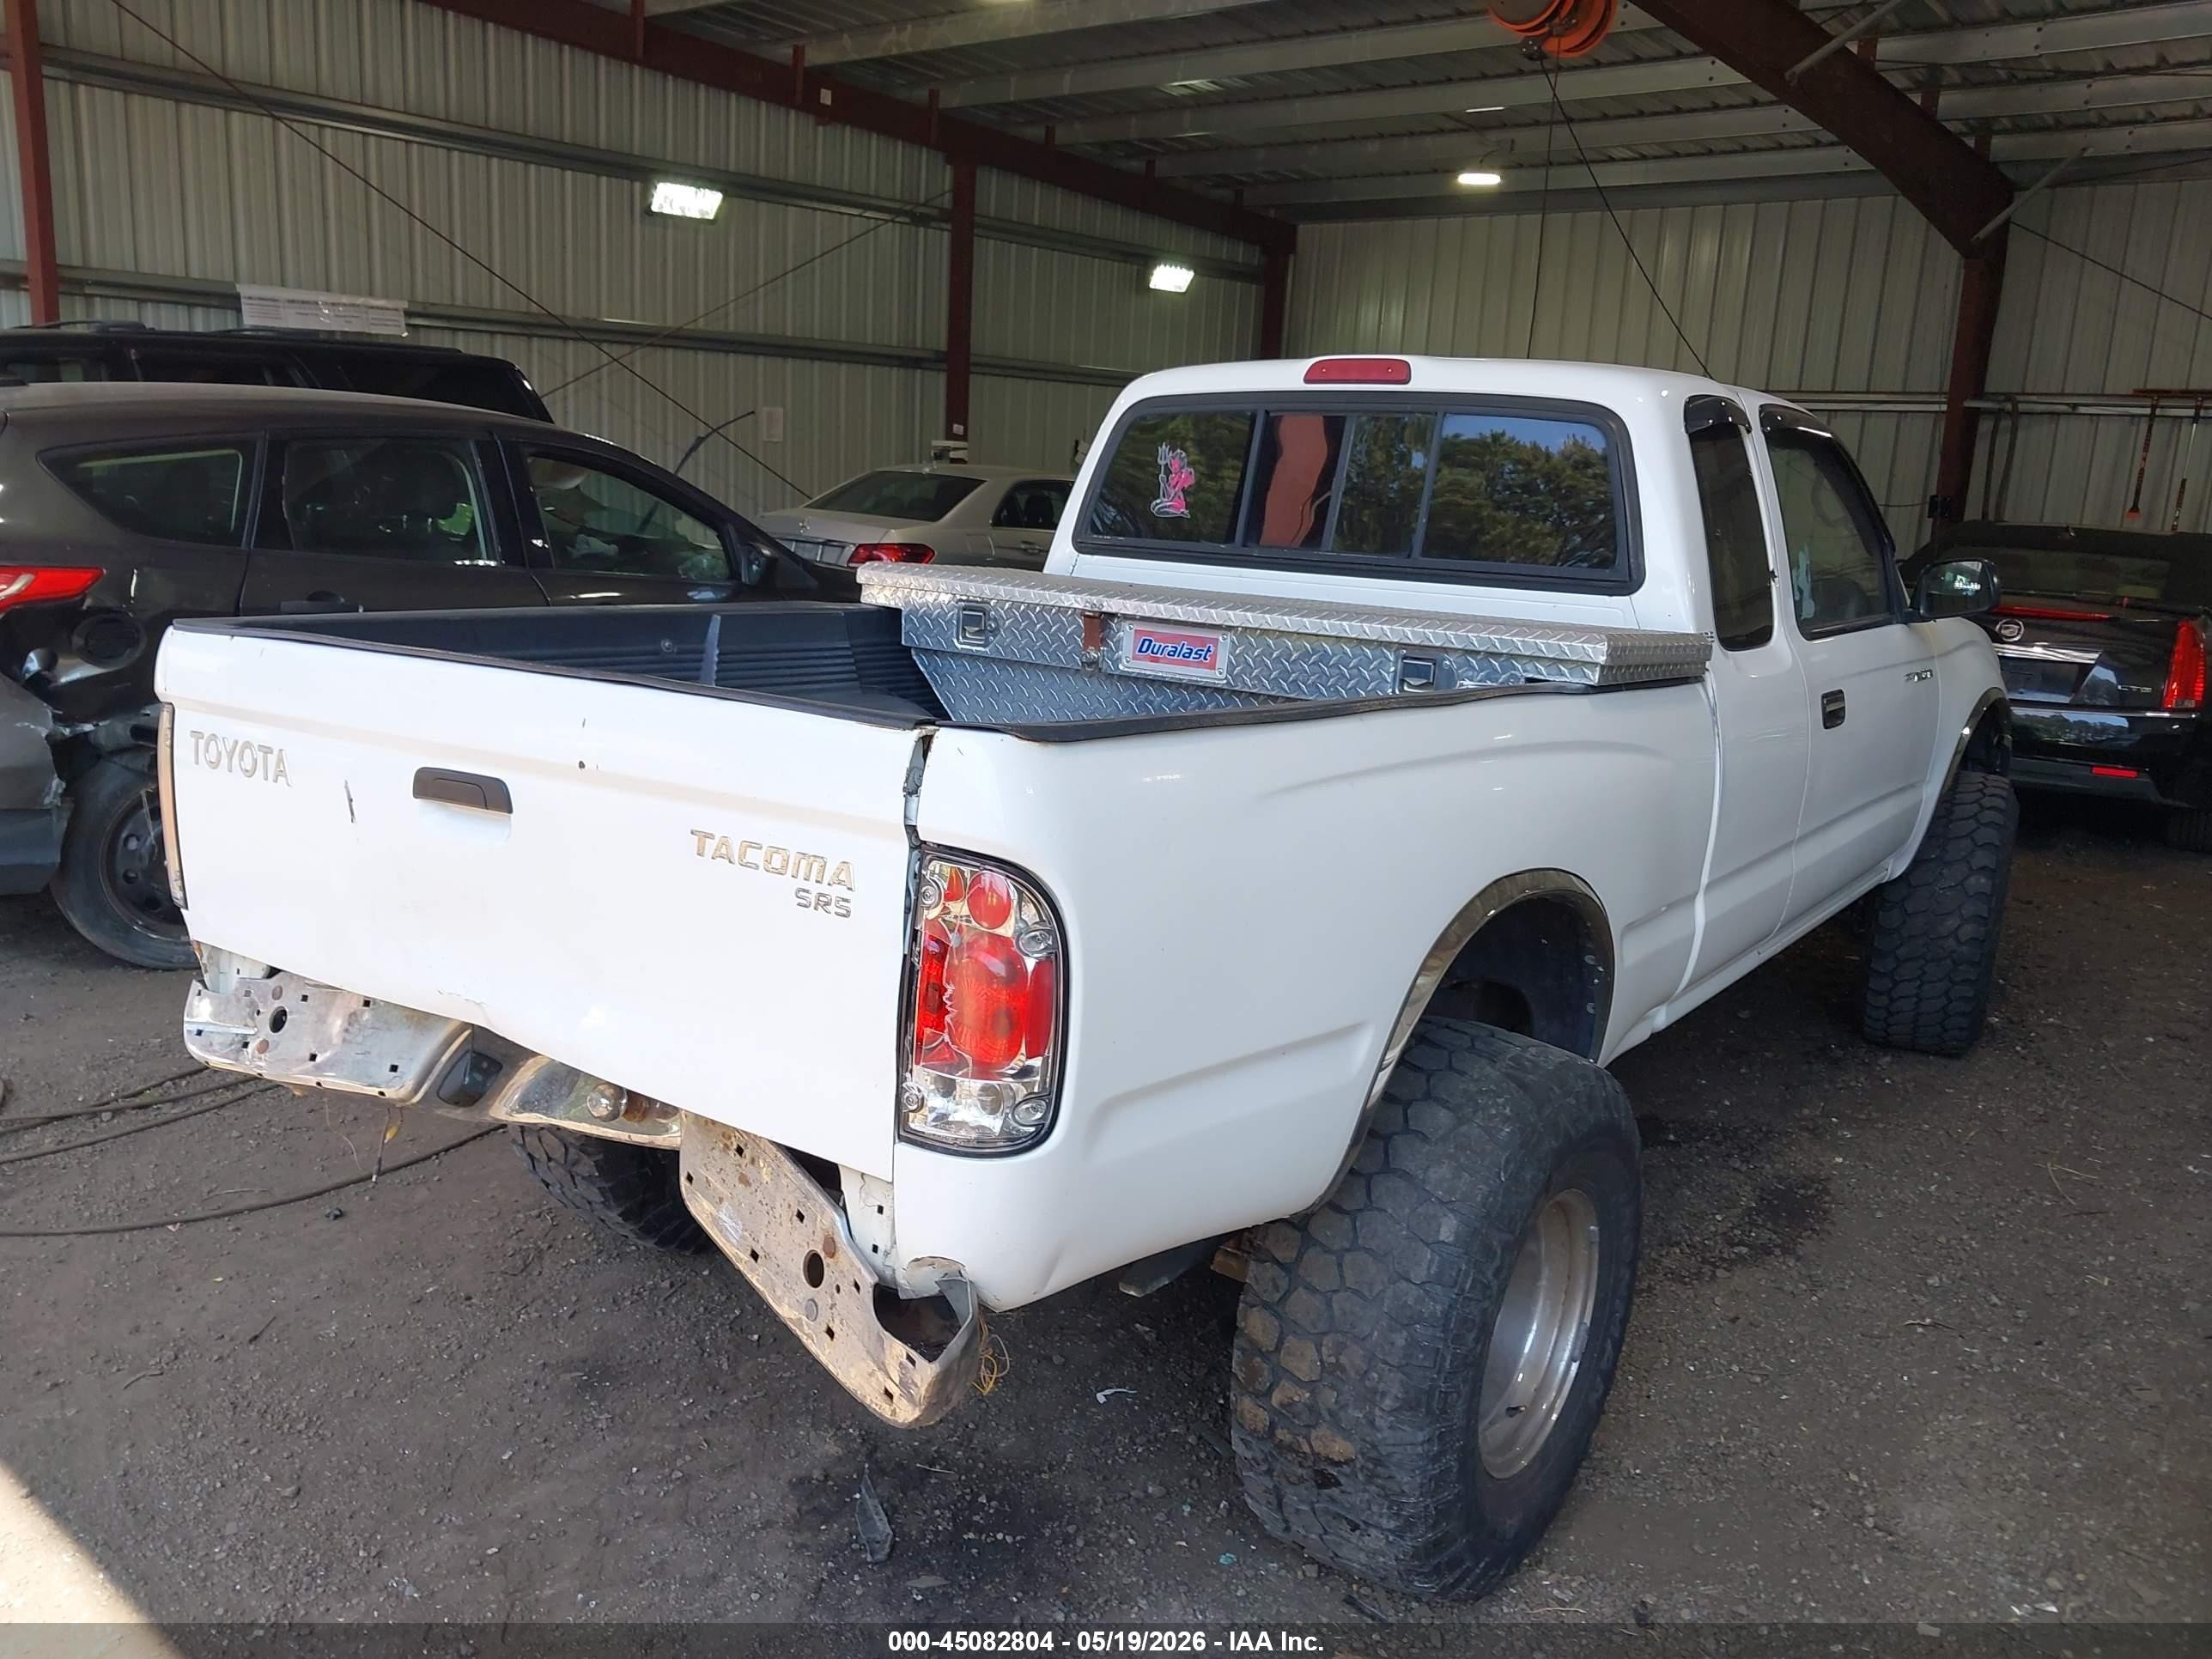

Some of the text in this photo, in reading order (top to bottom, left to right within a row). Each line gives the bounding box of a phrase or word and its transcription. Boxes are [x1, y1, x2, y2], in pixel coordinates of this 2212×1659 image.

[1136, 636, 1213, 661] Duralast
[189, 730, 294, 787] TOYOTA
[690, 829, 855, 891] TACOMA
